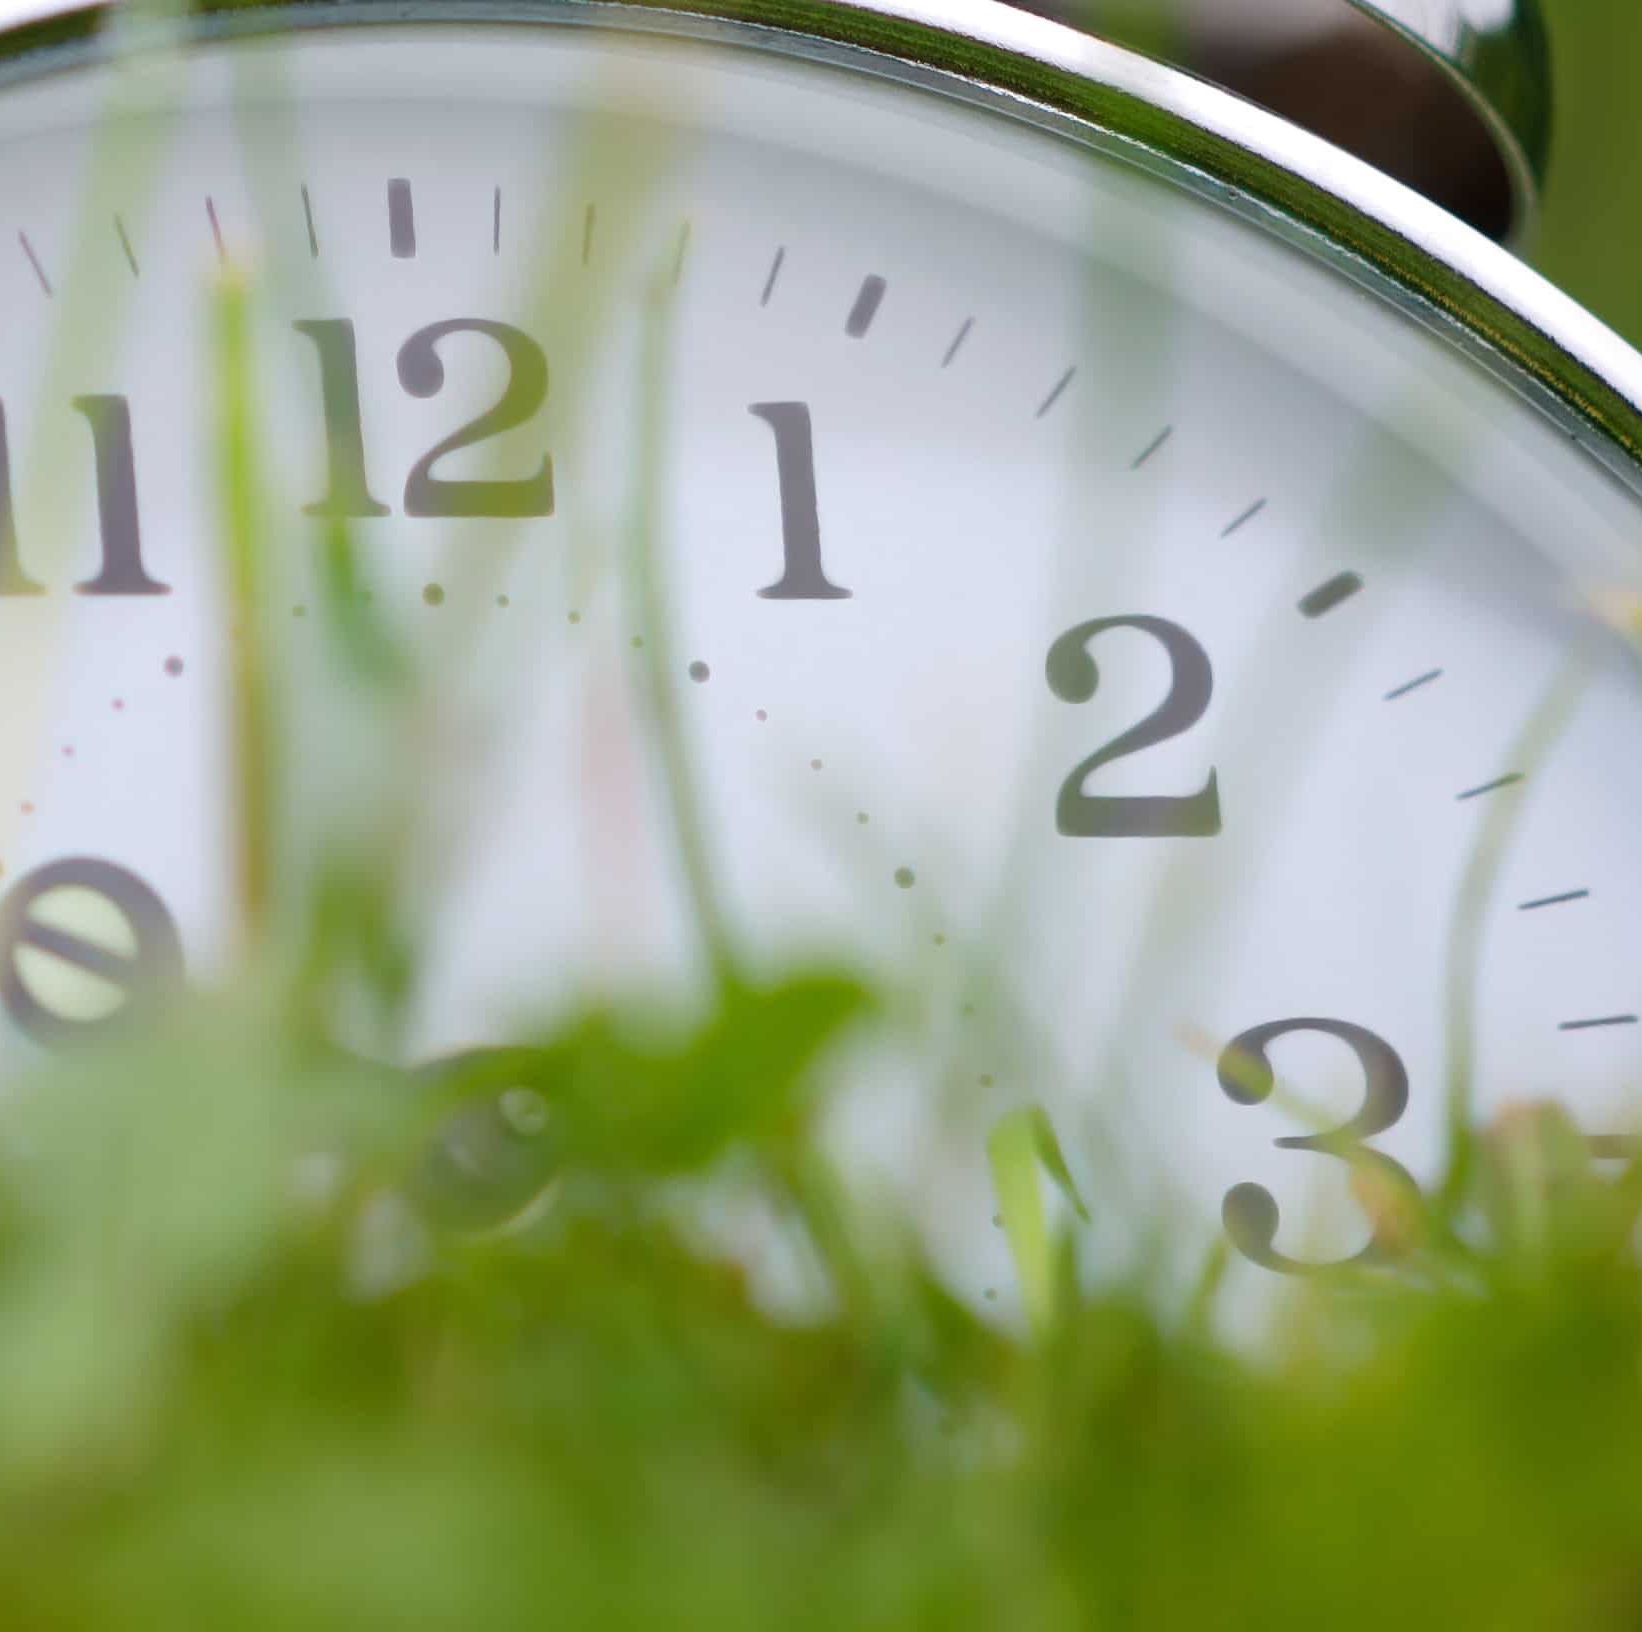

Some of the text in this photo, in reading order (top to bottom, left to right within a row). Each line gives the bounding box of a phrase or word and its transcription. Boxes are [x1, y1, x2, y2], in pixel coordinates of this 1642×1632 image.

[293, 317, 554, 517] 12
[748, 401, 853, 600] 1
[1045, 614, 1221, 837] 2
[1217, 1017, 1427, 1275] 3
